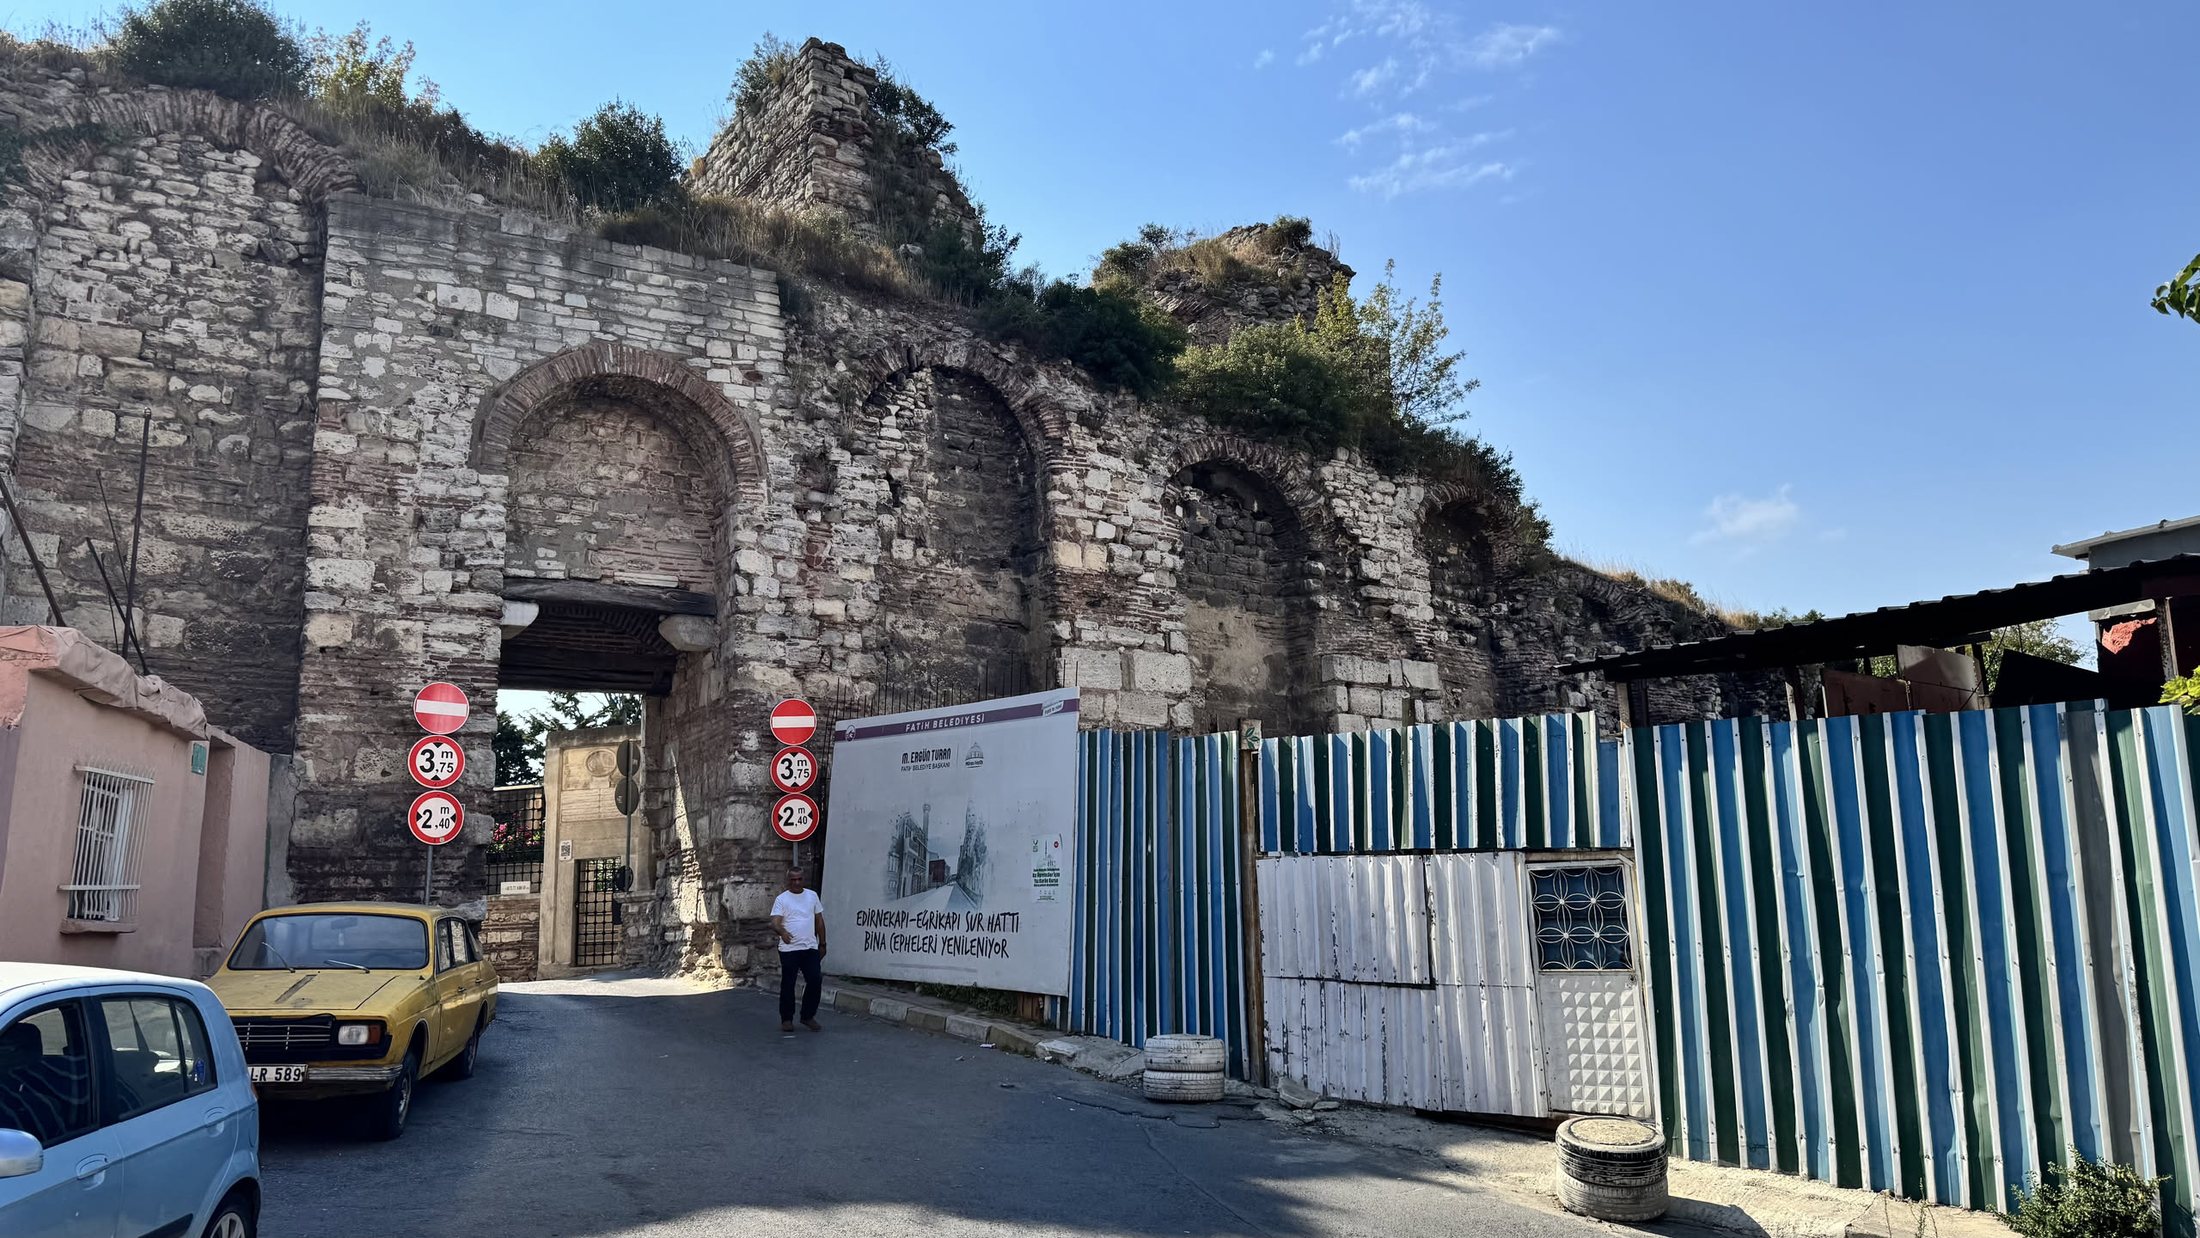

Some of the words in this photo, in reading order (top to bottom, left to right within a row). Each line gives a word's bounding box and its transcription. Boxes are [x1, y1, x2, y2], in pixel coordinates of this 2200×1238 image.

[905, 721, 930, 733] FATİH
[932, 713, 985, 729] BELEDİYESİ
[911, 748, 930, 763] ERGÜN
[932, 747, 951, 761] TURAN
[965, 911, 985, 932] SUR
[987, 912, 1020, 933] HATTI
[864, 931, 887, 952] BİNA
[941, 935, 1009, 959] YENİLENİYOR
[274, 1067, 301, 1081] 589
